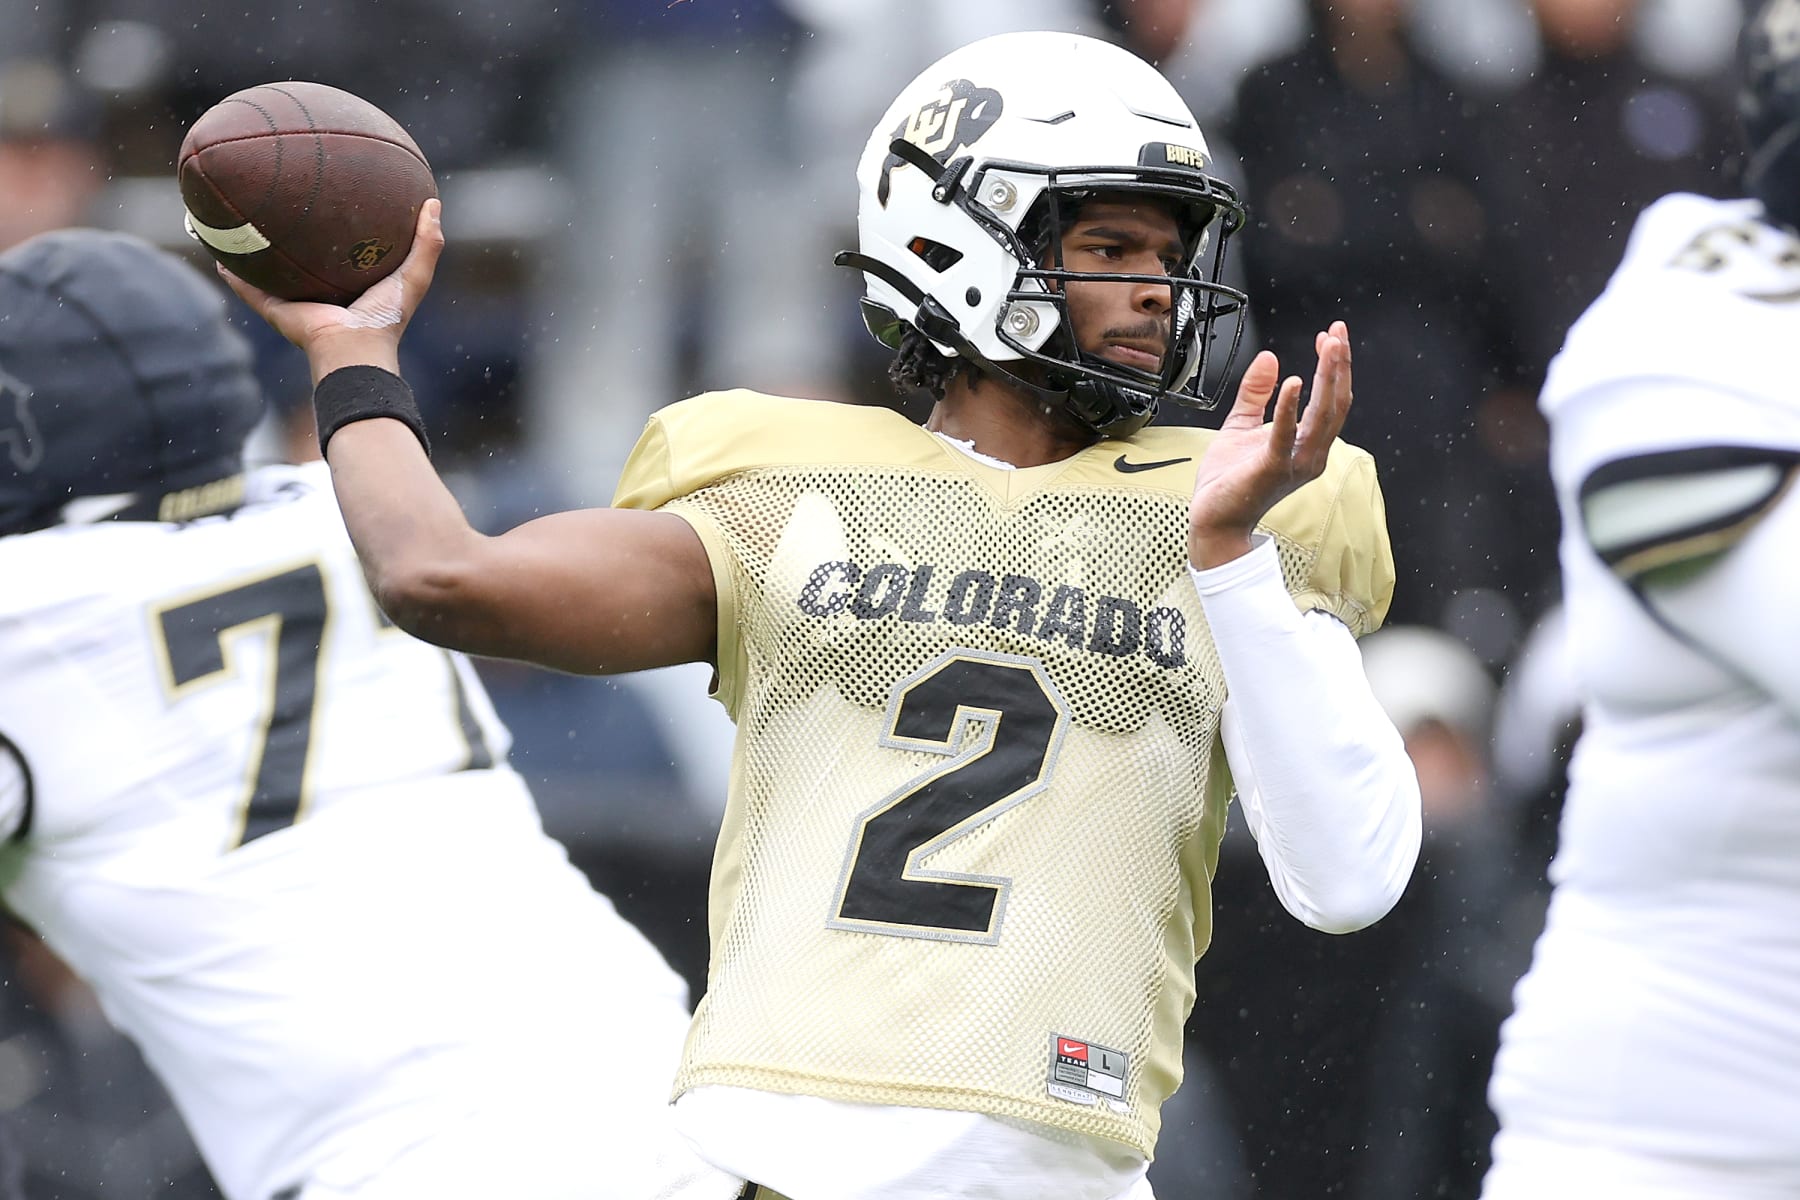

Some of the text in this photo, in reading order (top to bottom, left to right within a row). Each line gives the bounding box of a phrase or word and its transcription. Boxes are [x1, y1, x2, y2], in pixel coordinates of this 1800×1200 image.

[1166, 144, 1204, 168] BUFFS
[798, 560, 1187, 669] COLORADO
[150, 557, 334, 850] 7
[825, 647, 1072, 945] 2
[1061, 1056, 1086, 1067] TEAM
[1102, 1054, 1110, 1070] L
